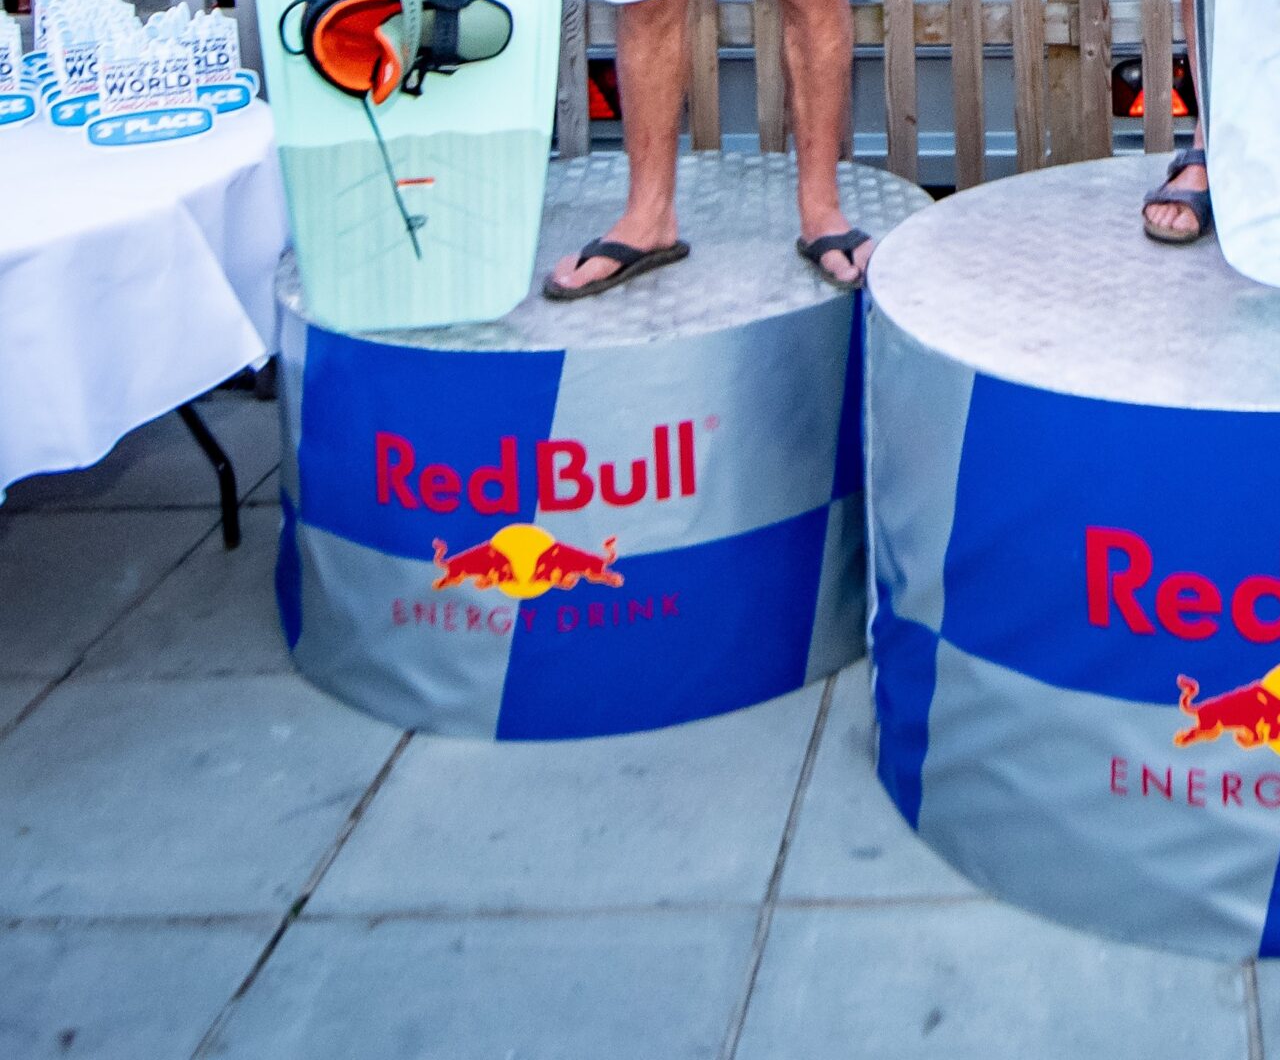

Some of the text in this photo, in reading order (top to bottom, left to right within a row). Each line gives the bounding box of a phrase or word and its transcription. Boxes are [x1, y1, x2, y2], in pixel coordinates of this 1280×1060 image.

[374, 419, 697, 515] Red Bull
[392, 592, 682, 636] ENERGY DRINK
